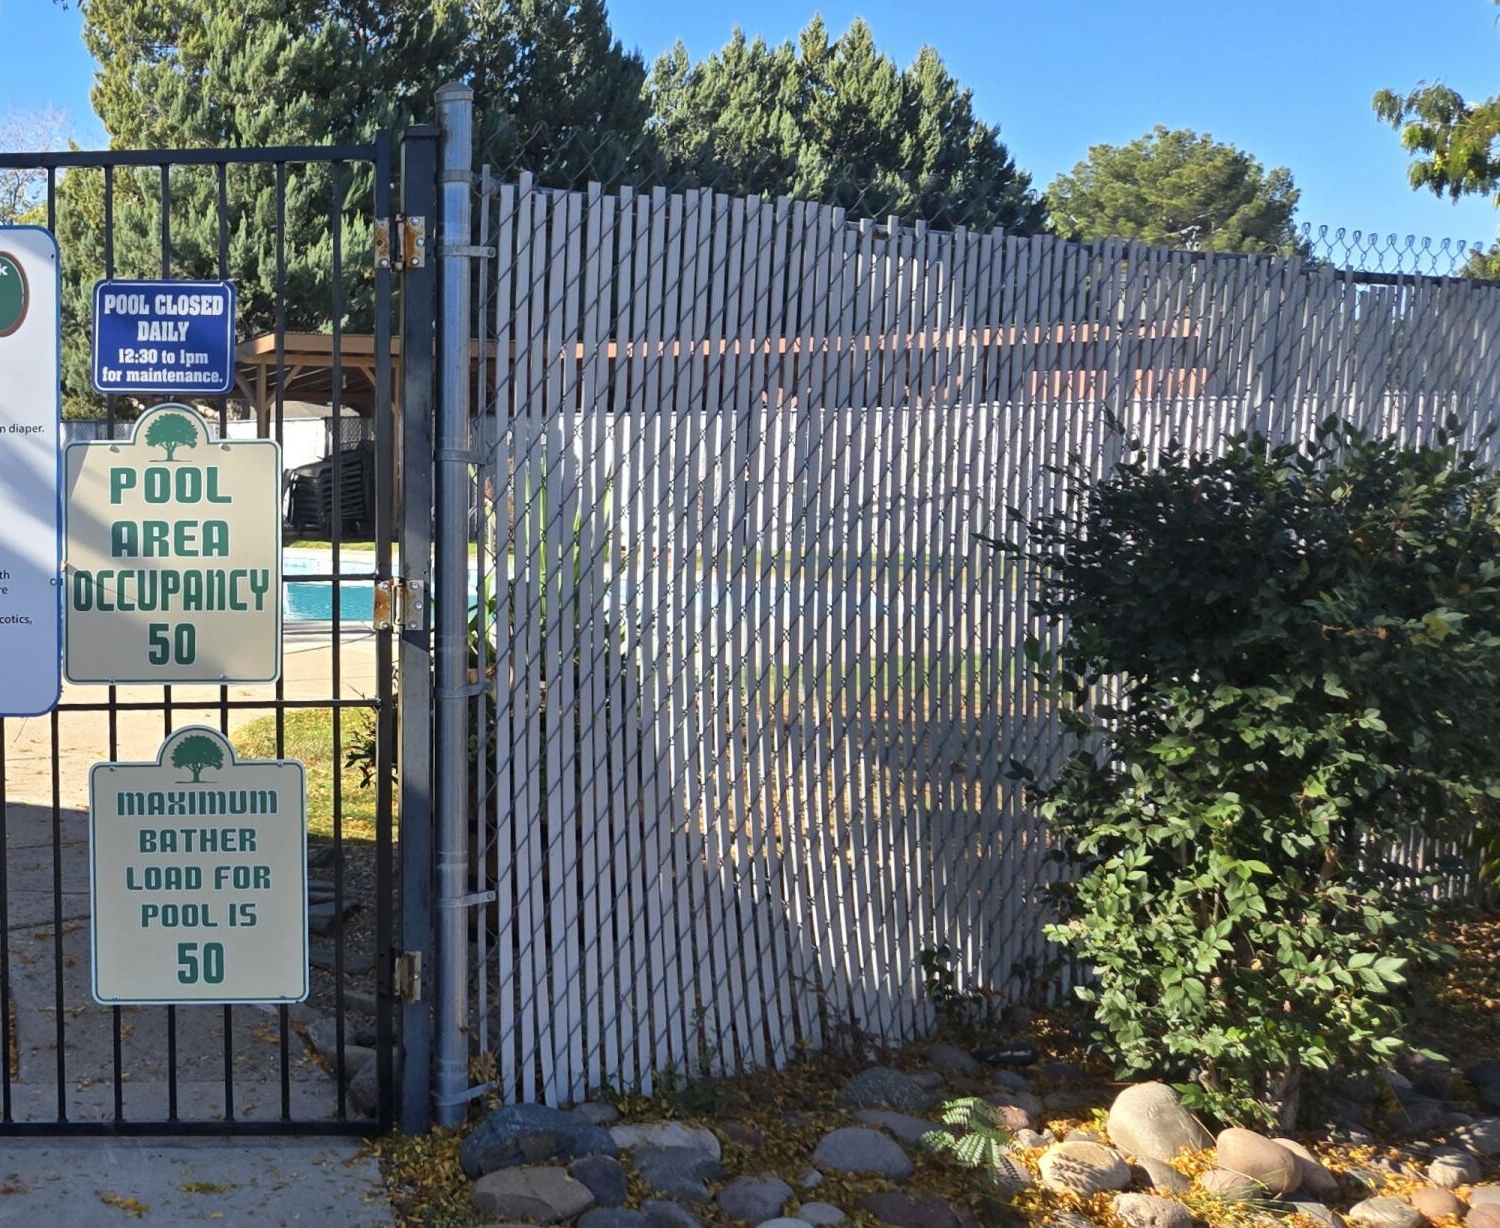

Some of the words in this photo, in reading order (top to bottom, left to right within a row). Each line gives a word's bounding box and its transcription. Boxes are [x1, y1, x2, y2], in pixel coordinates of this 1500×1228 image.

[104, 295, 149, 315] POOL
[154, 295, 223, 315] CLOSED
[137, 321, 190, 341] DAILY
[118, 349, 157, 364] 12:30
[162, 350, 176, 364] to
[179, 349, 209, 366] 1pm
[102, 368, 123, 382] for
[126, 368, 223, 383] maintenance.
[110, 467, 232, 504] POOL
[111, 520, 229, 557] AREA
[74, 569, 269, 612] OCCUPANCY
[148, 623, 197, 665] 50
[117, 790, 278, 815] MAXIMUM
[140, 829, 256, 852] BATHER
[126, 867, 202, 890] LOAD
[215, 866, 271, 889] FOR
[142, 904, 218, 927] POOL
[229, 903, 257, 927] IS
[178, 942, 224, 984] 50
